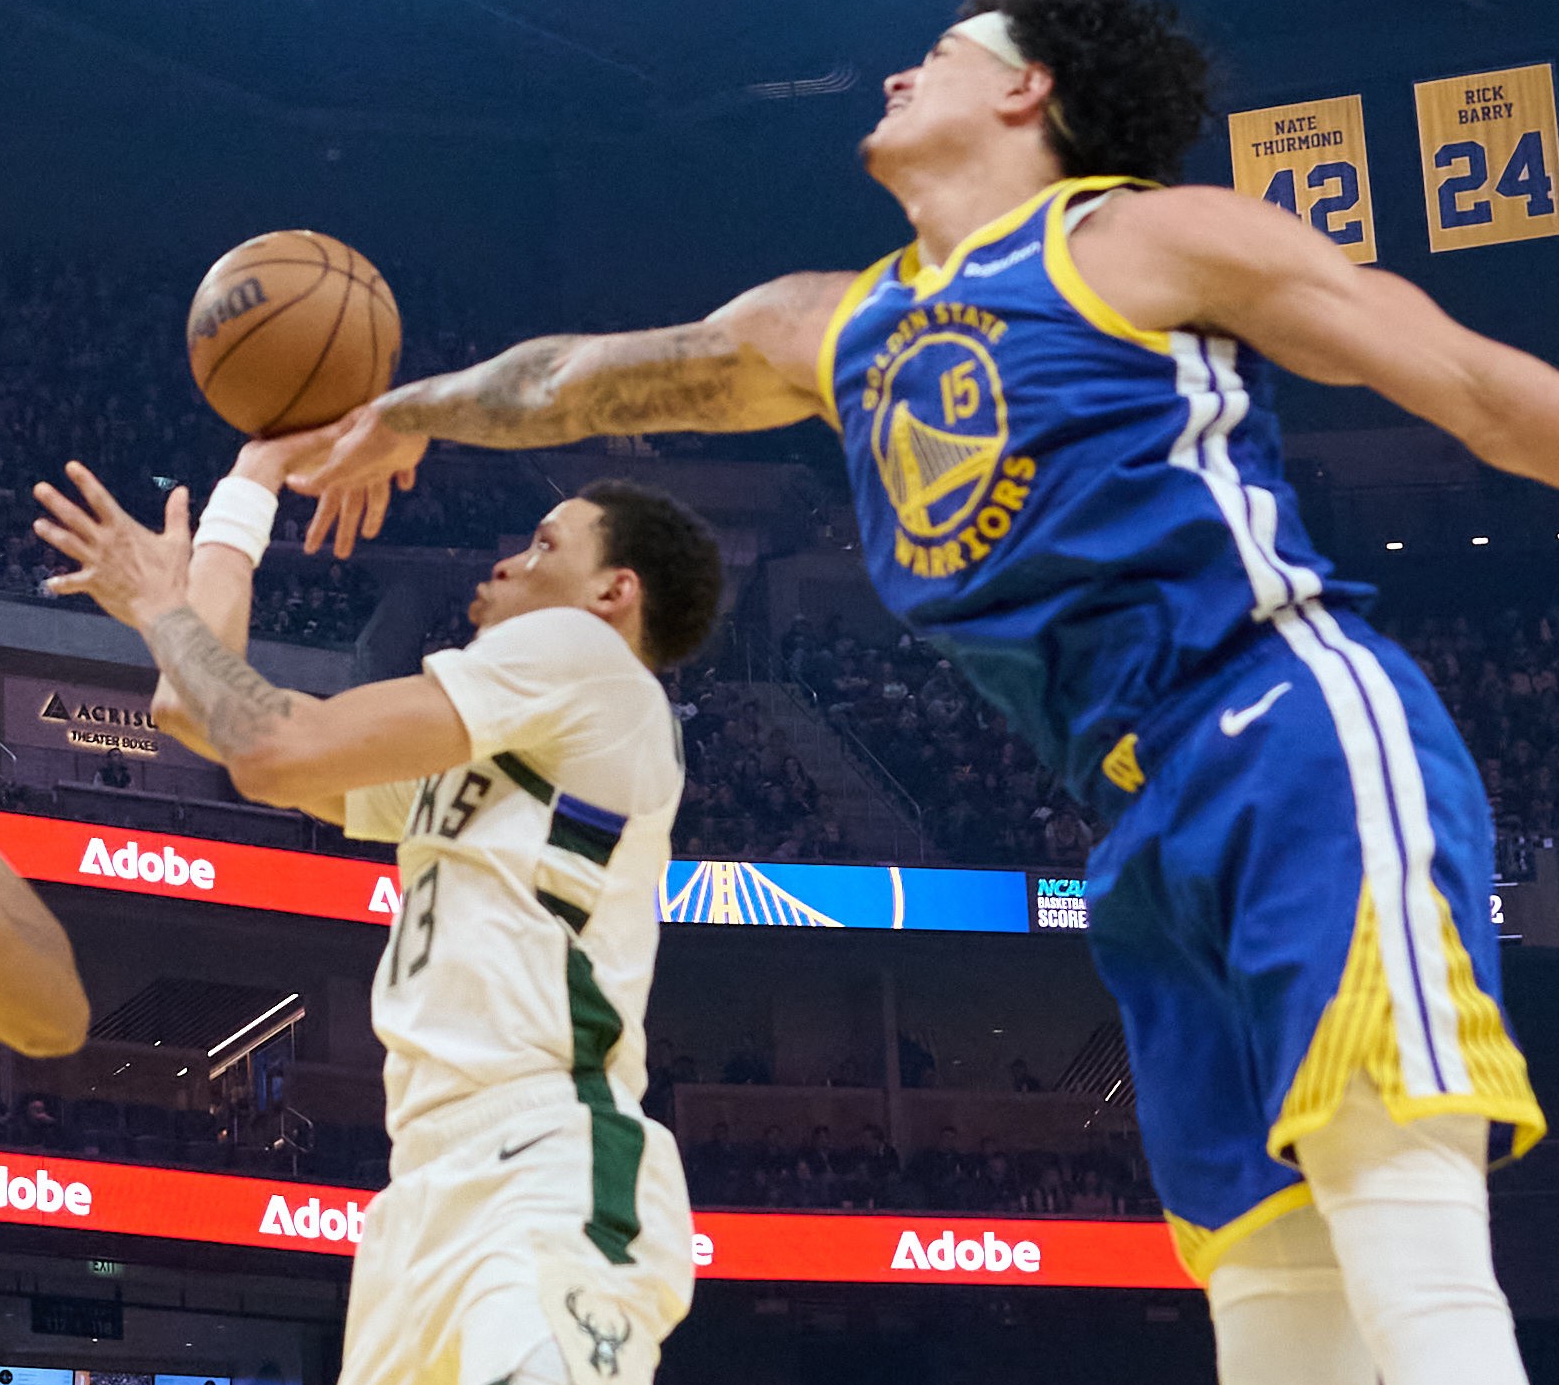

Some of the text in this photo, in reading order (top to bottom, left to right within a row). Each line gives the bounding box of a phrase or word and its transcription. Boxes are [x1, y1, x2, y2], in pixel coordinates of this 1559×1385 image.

[1465, 85, 1505, 105] RICK
[1274, 116, 1318, 135] NATE
[1458, 102, 1514, 125] BARRY
[1252, 130, 1344, 158] THURMOND
[1434, 130, 1556, 230] 24
[1261, 161, 1364, 245] 42
[933, 302, 1008, 345] STATE
[939, 360, 980, 424] 15
[893, 455, 1037, 578] WARRIORS
[72, 731, 158, 753] THEATER BOXES
[79, 838, 216, 890] Adobe
[1037, 897, 1087, 911] BASKETBA
[1038, 910, 1089, 928] SCORE
[891, 1230, 1040, 1273] Adobe
